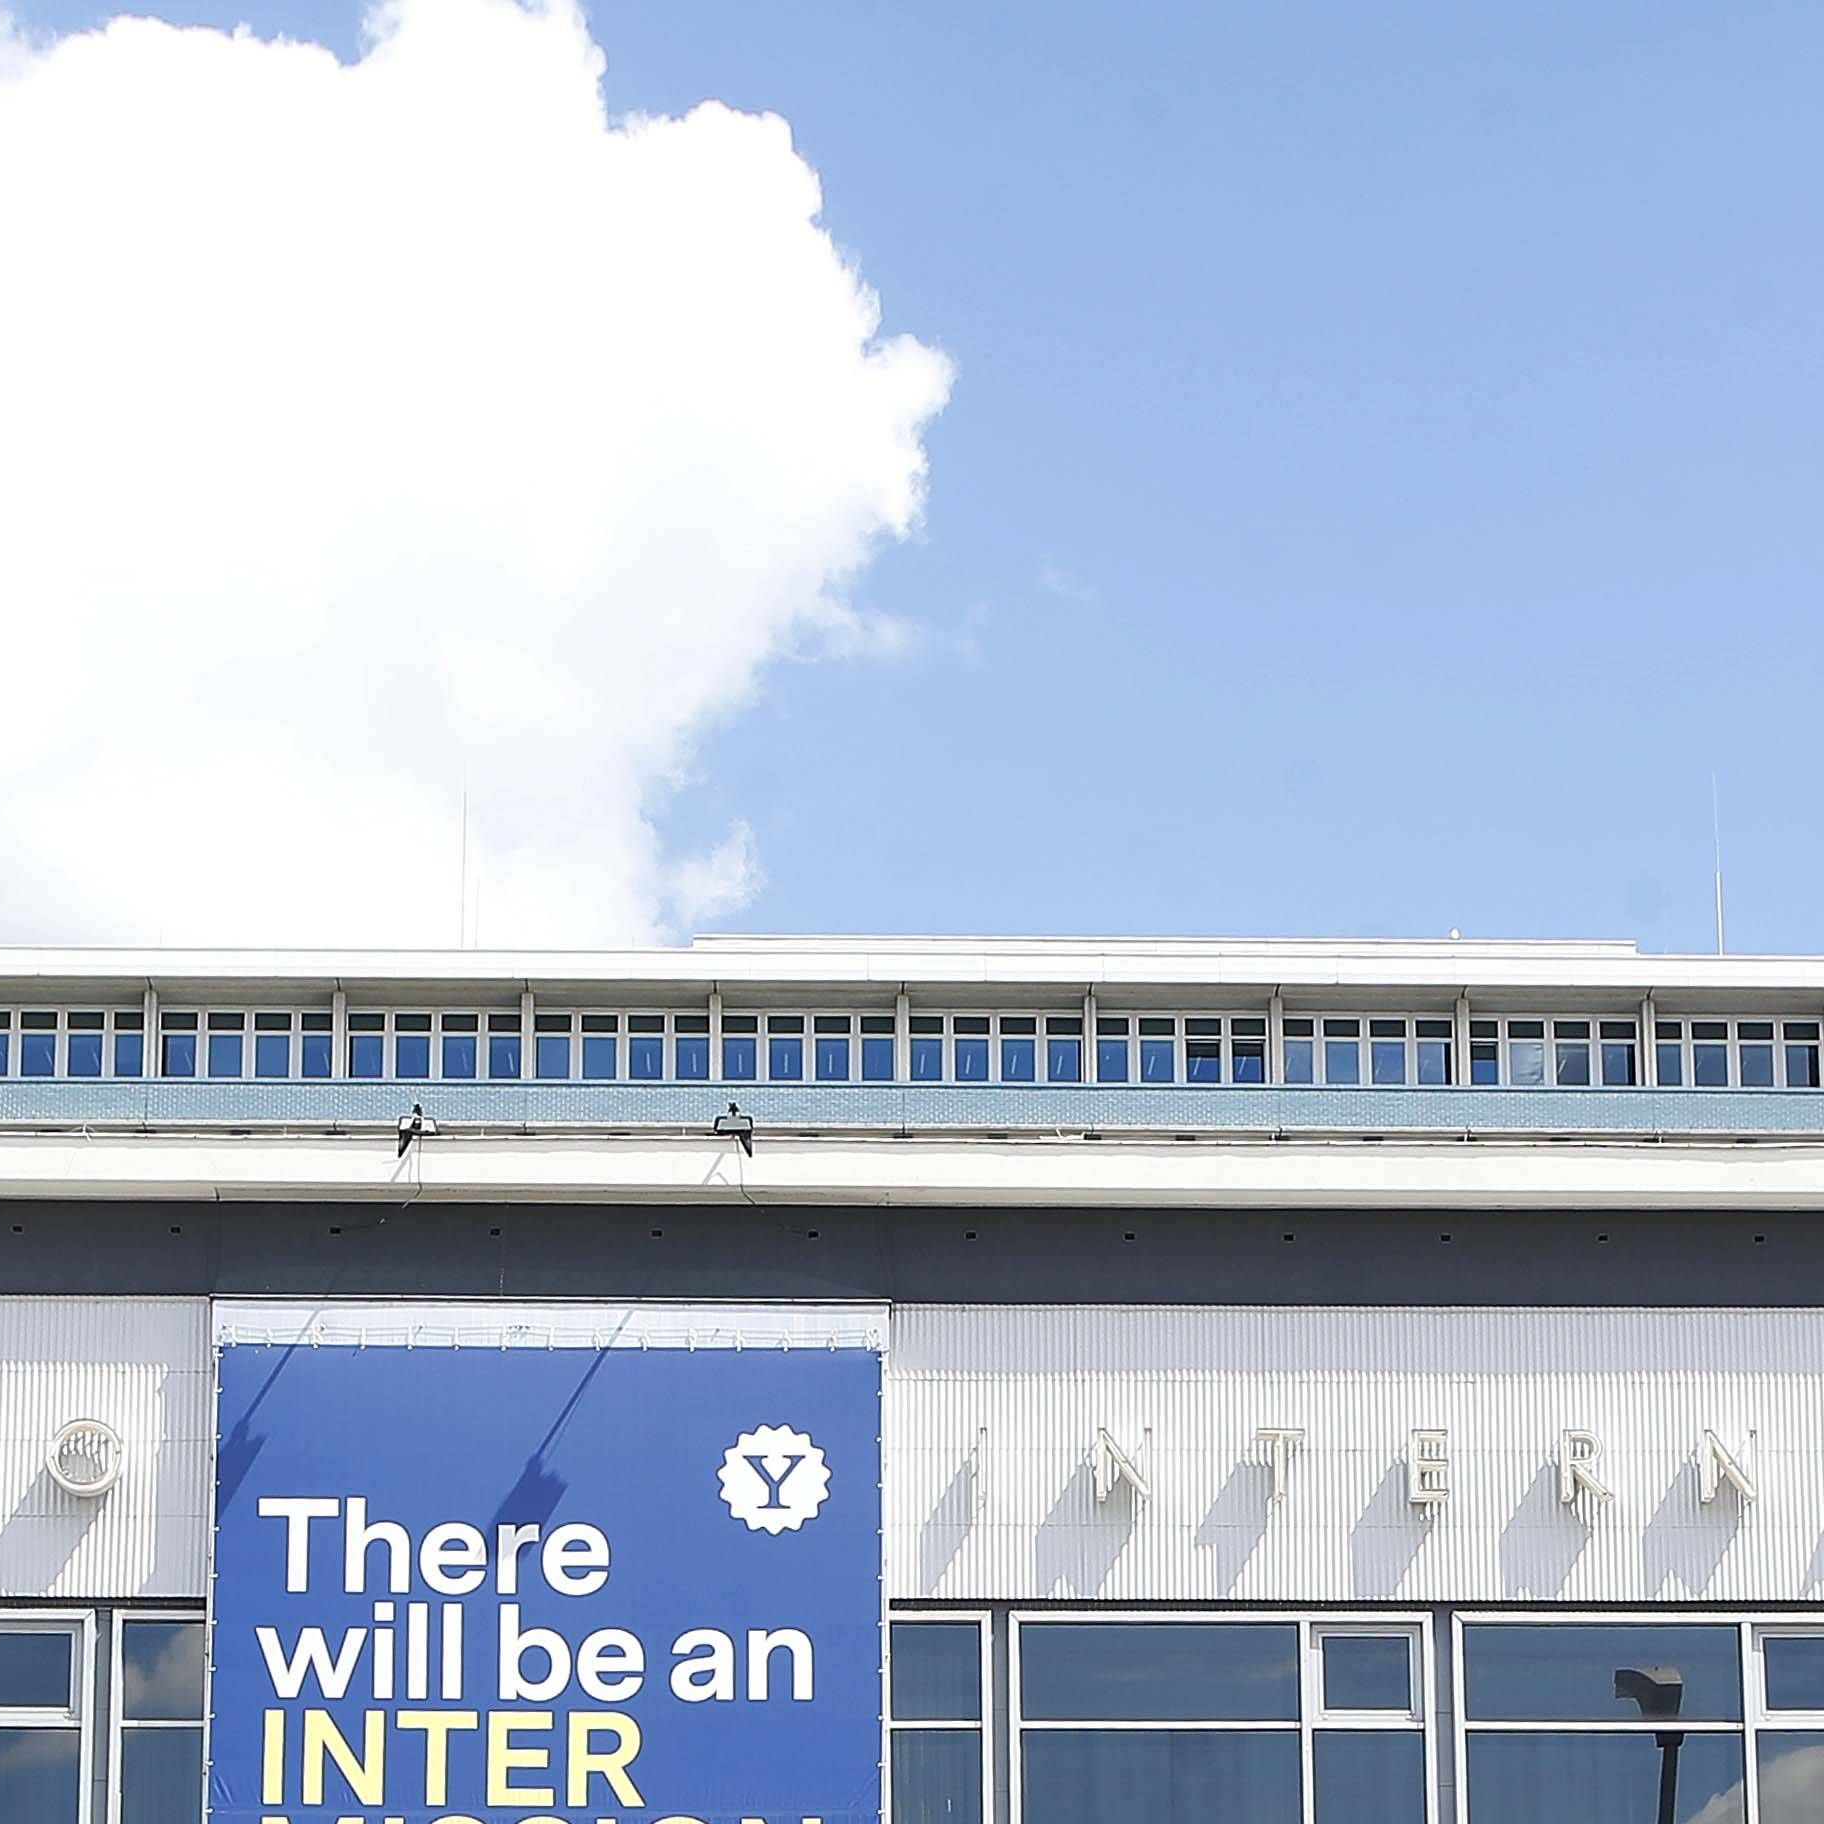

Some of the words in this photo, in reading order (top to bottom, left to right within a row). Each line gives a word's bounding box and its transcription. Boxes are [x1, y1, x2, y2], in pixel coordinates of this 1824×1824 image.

[258, 1497, 610, 1595] There
[256, 1602, 463, 1700] will
[499, 1602, 645, 1702] be
[670, 1628, 814, 1702] an
[262, 1709, 645, 1807] INTER
